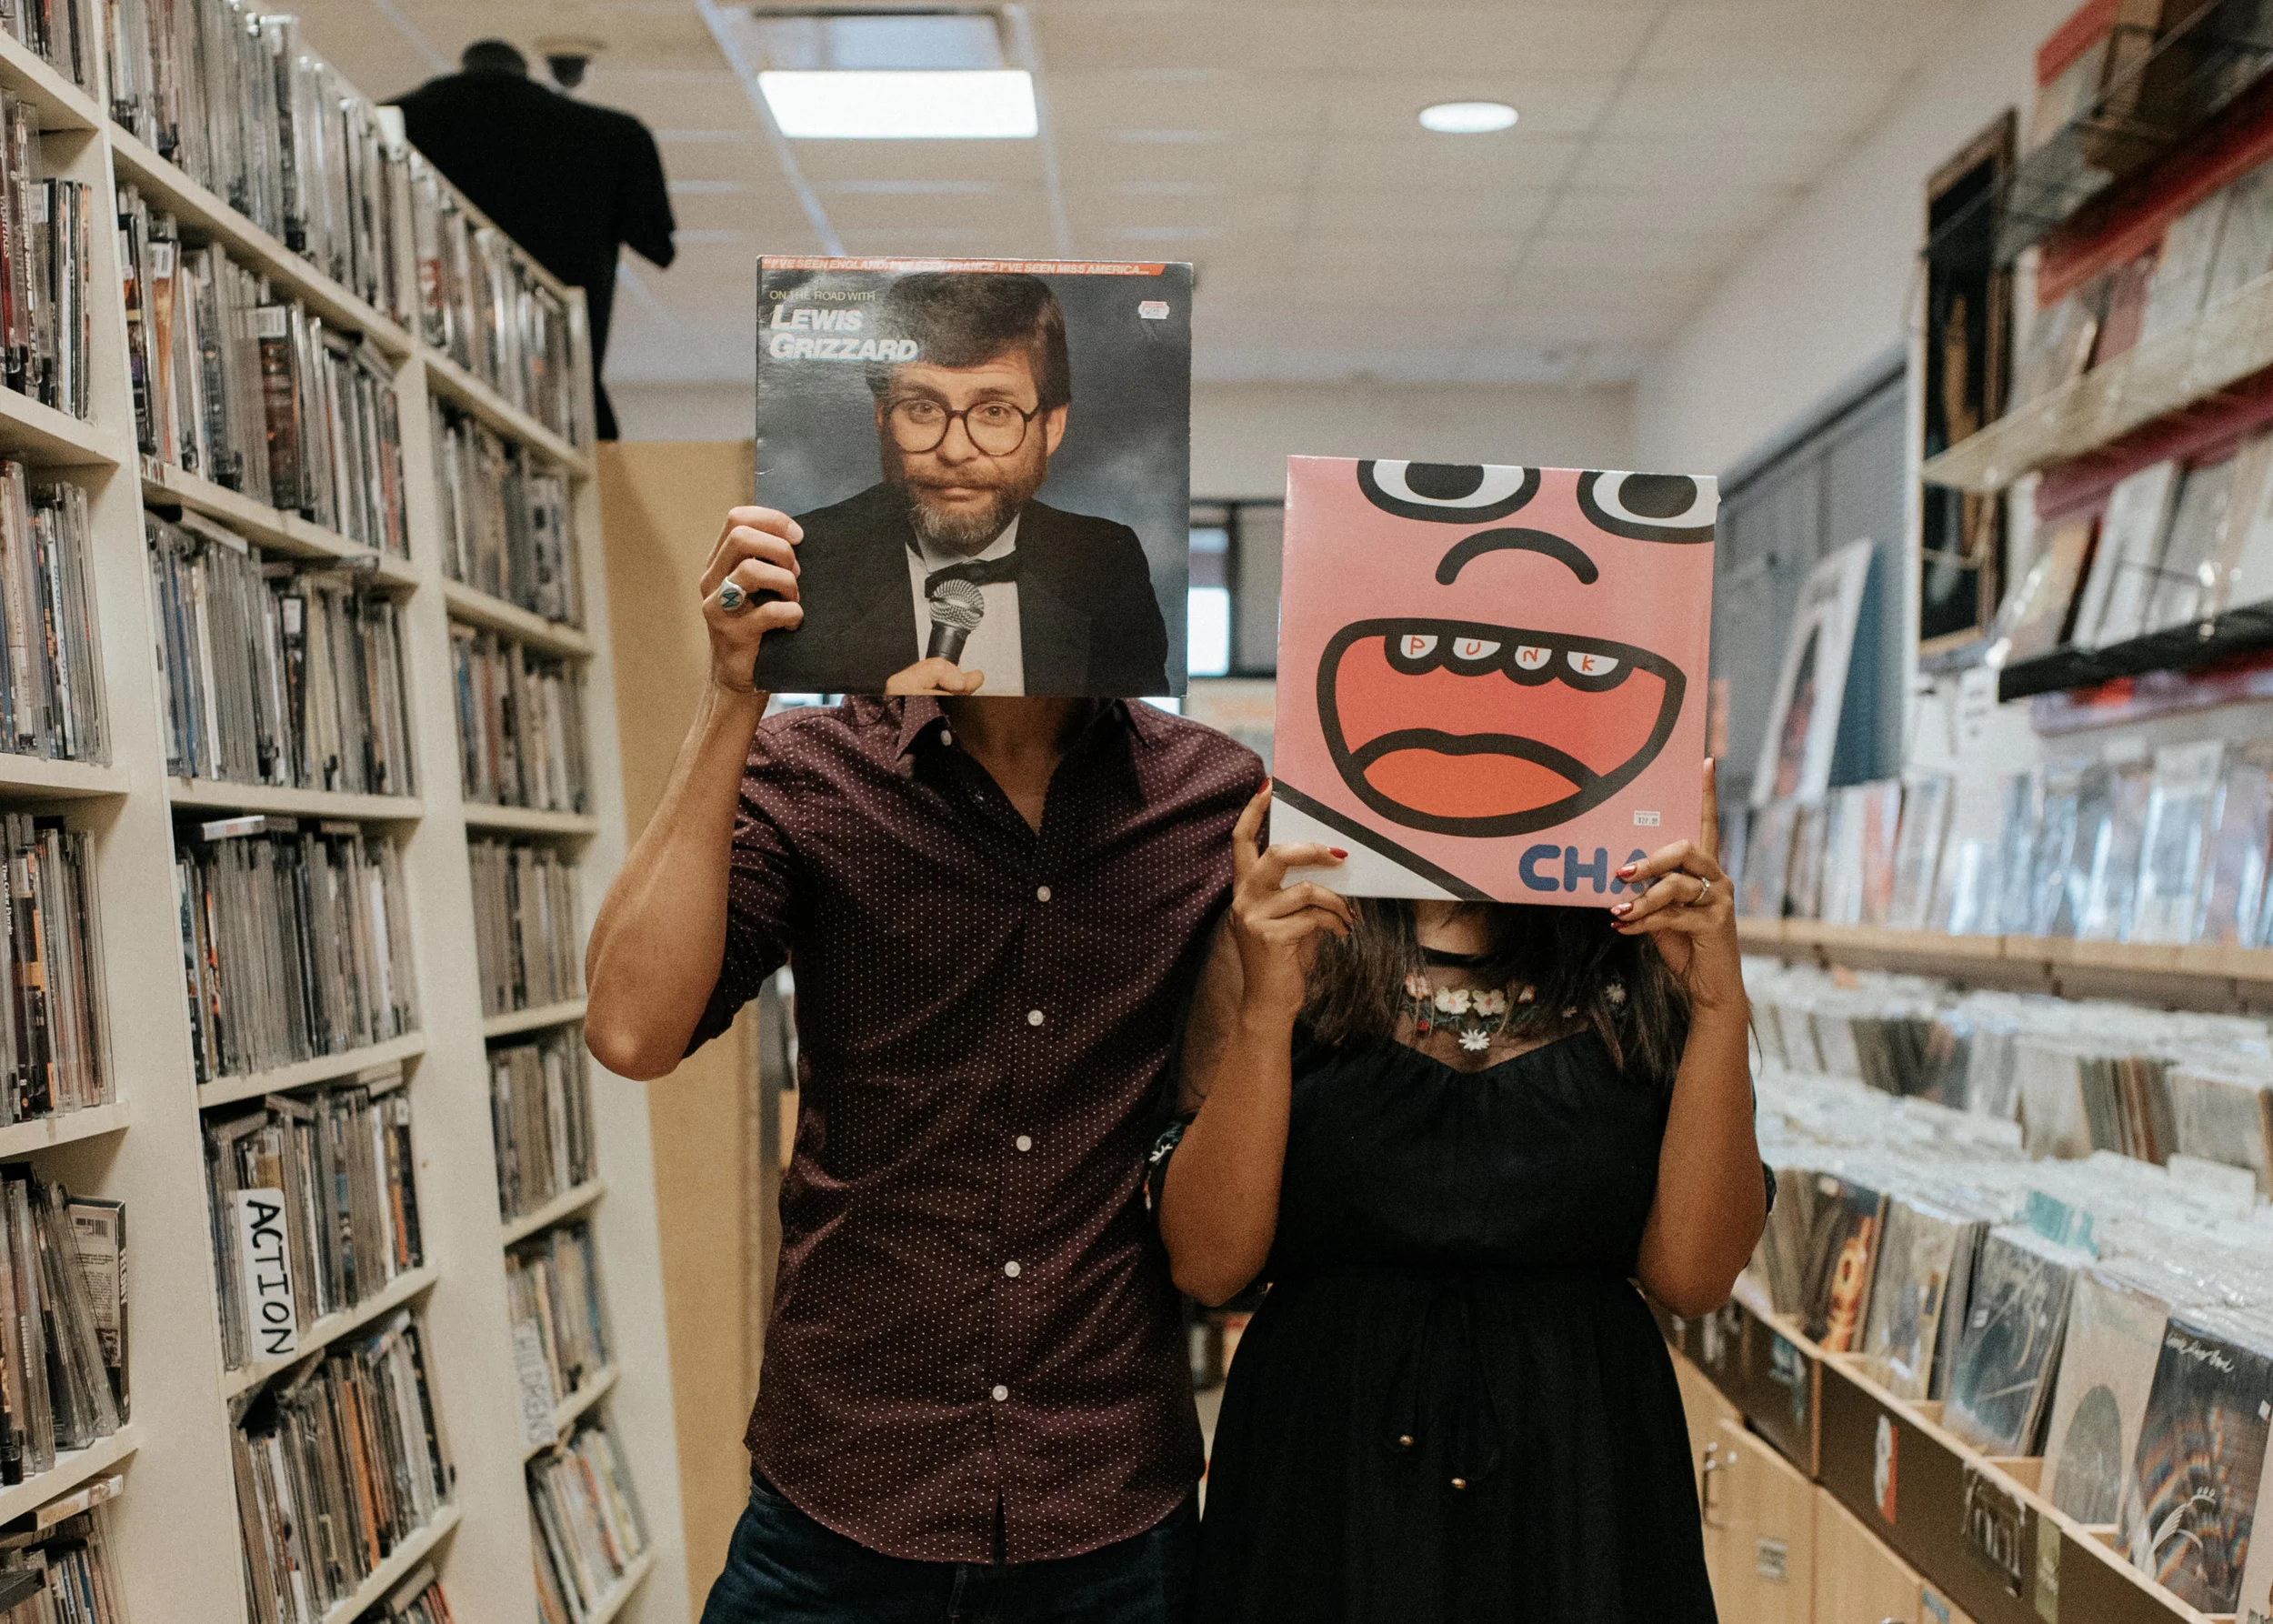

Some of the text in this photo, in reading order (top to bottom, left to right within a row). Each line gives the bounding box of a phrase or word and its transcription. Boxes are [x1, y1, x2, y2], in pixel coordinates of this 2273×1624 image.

[796, 258, 828, 269] SEEN
[998, 262, 1023, 273] I'VE
[1024, 263, 1056, 274] SEEN
[1057, 264, 1086, 275] MISS
[769, 290, 876, 301] ON THE ROAD WITH
[770, 304, 864, 333] LEWIS
[769, 332, 920, 363] GRIZZARD
[1409, 635, 1596, 673] PUNK
[119, 1247, 128, 1305] FELONY
[245, 1197, 295, 1355] ACTION
